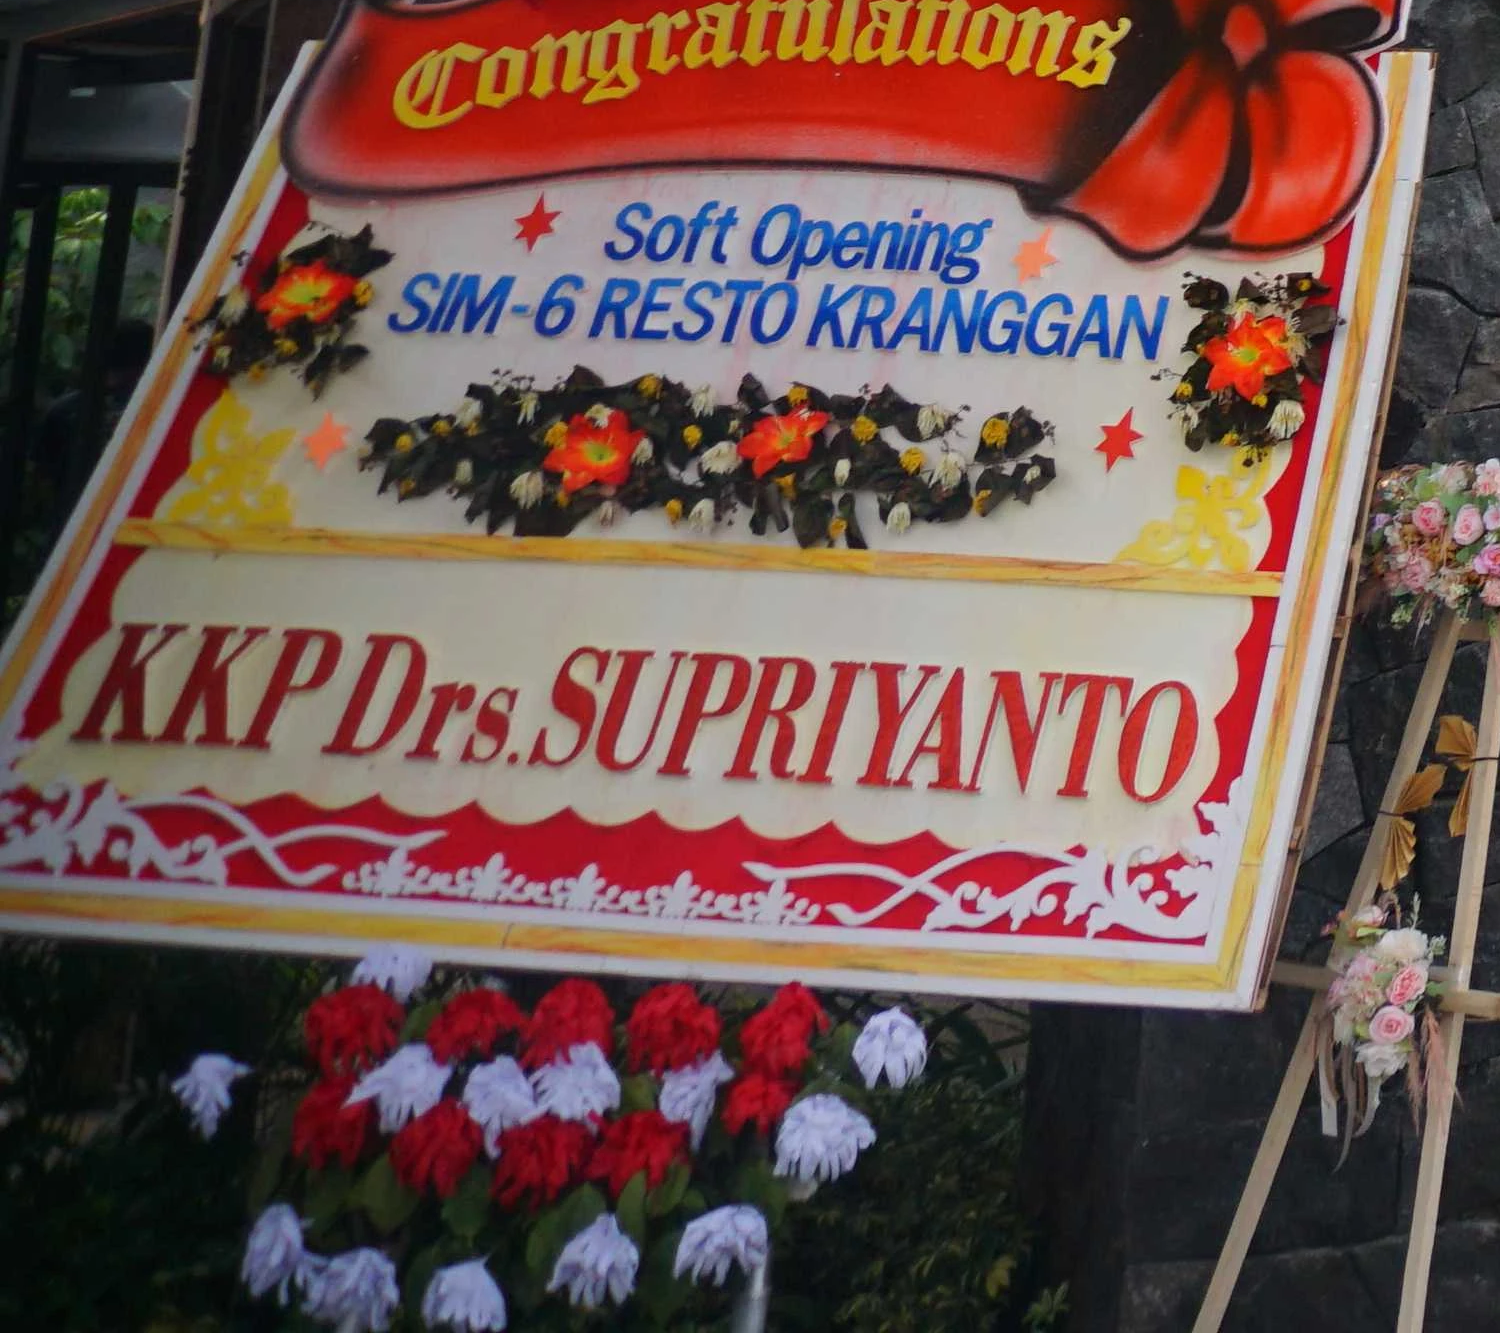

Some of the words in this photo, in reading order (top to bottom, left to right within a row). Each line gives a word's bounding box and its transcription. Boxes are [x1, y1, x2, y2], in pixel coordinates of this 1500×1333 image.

[603, 201, 738, 265] Soft
[751, 205, 994, 284] Opening
[387, 272, 582, 334] SIM-6
[595, 278, 797, 346] RESTO
[806, 282, 1171, 362] KRANGGAN
[82, 623, 341, 753] KKP
